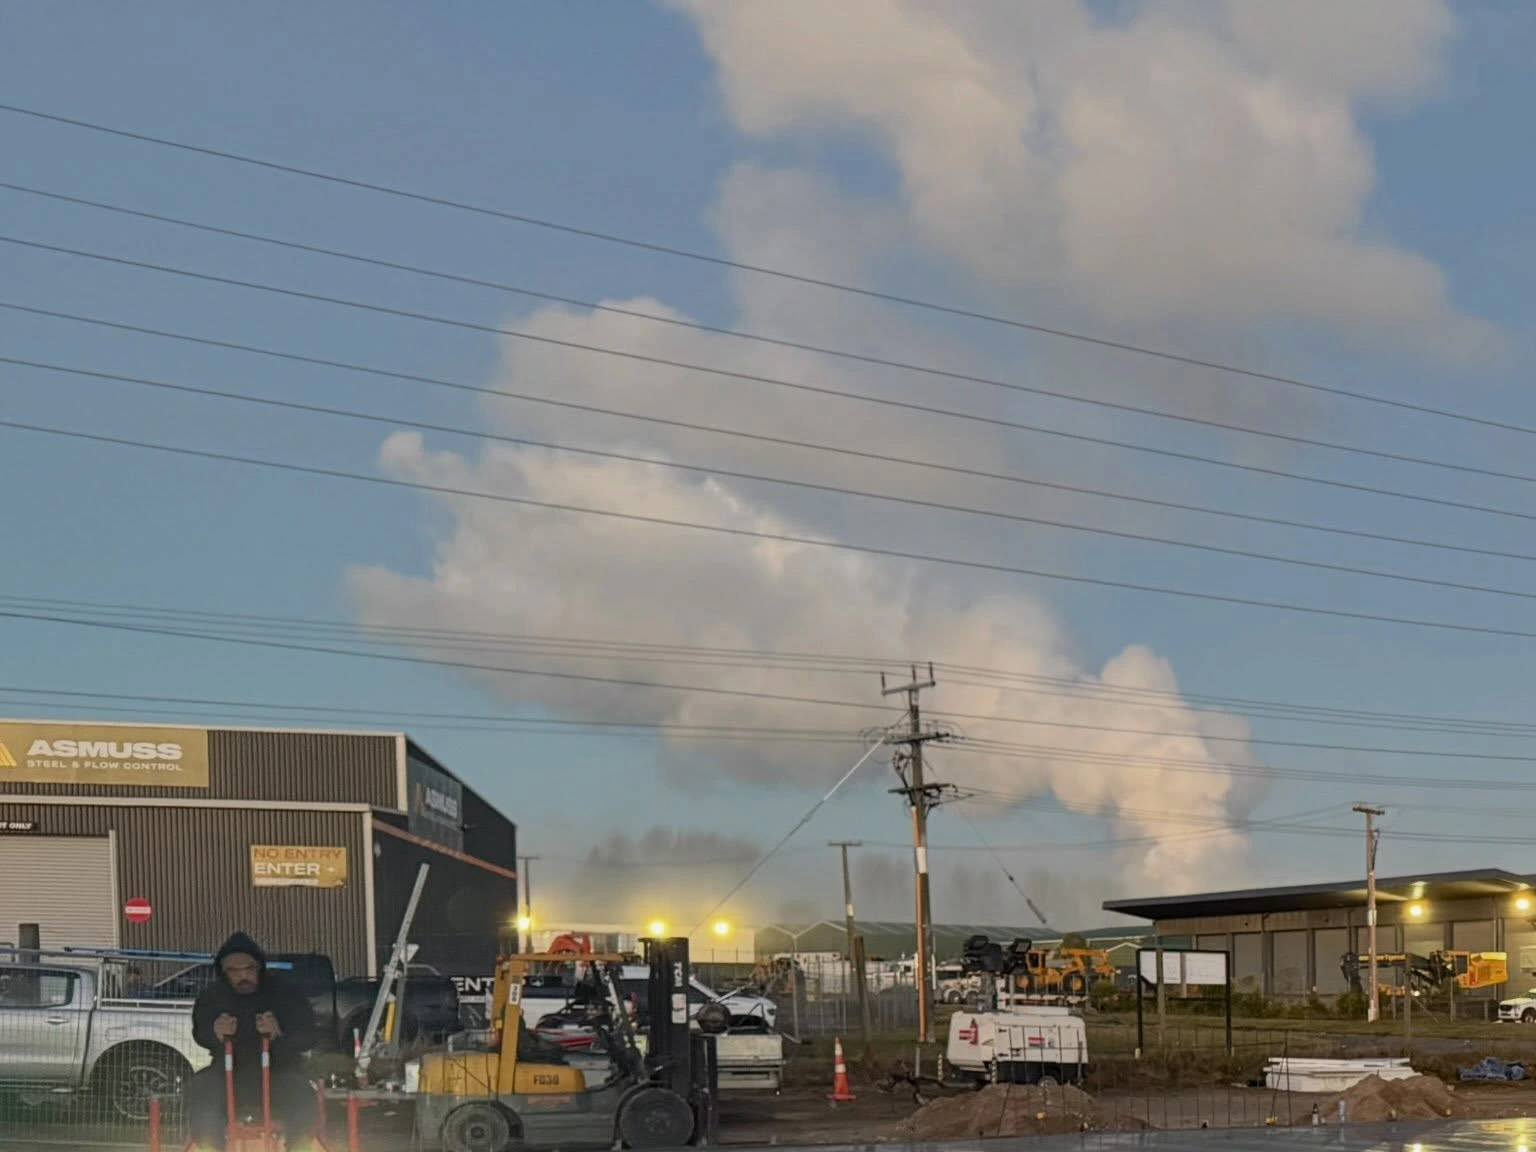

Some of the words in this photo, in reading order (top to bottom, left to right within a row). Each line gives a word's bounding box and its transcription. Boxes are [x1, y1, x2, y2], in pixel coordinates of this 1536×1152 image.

[27, 739, 183, 760] ASMUSS
[27, 759, 67, 769] STEEL
[71, 761, 80, 769] &
[84, 761, 119, 770] FLOW
[123, 763, 183, 772] CONTROL
[9, 822, 32, 830] ONLY
[254, 847, 280, 859] NO
[285, 848, 341, 859] ENTRY
[254, 862, 320, 875] ENTER
